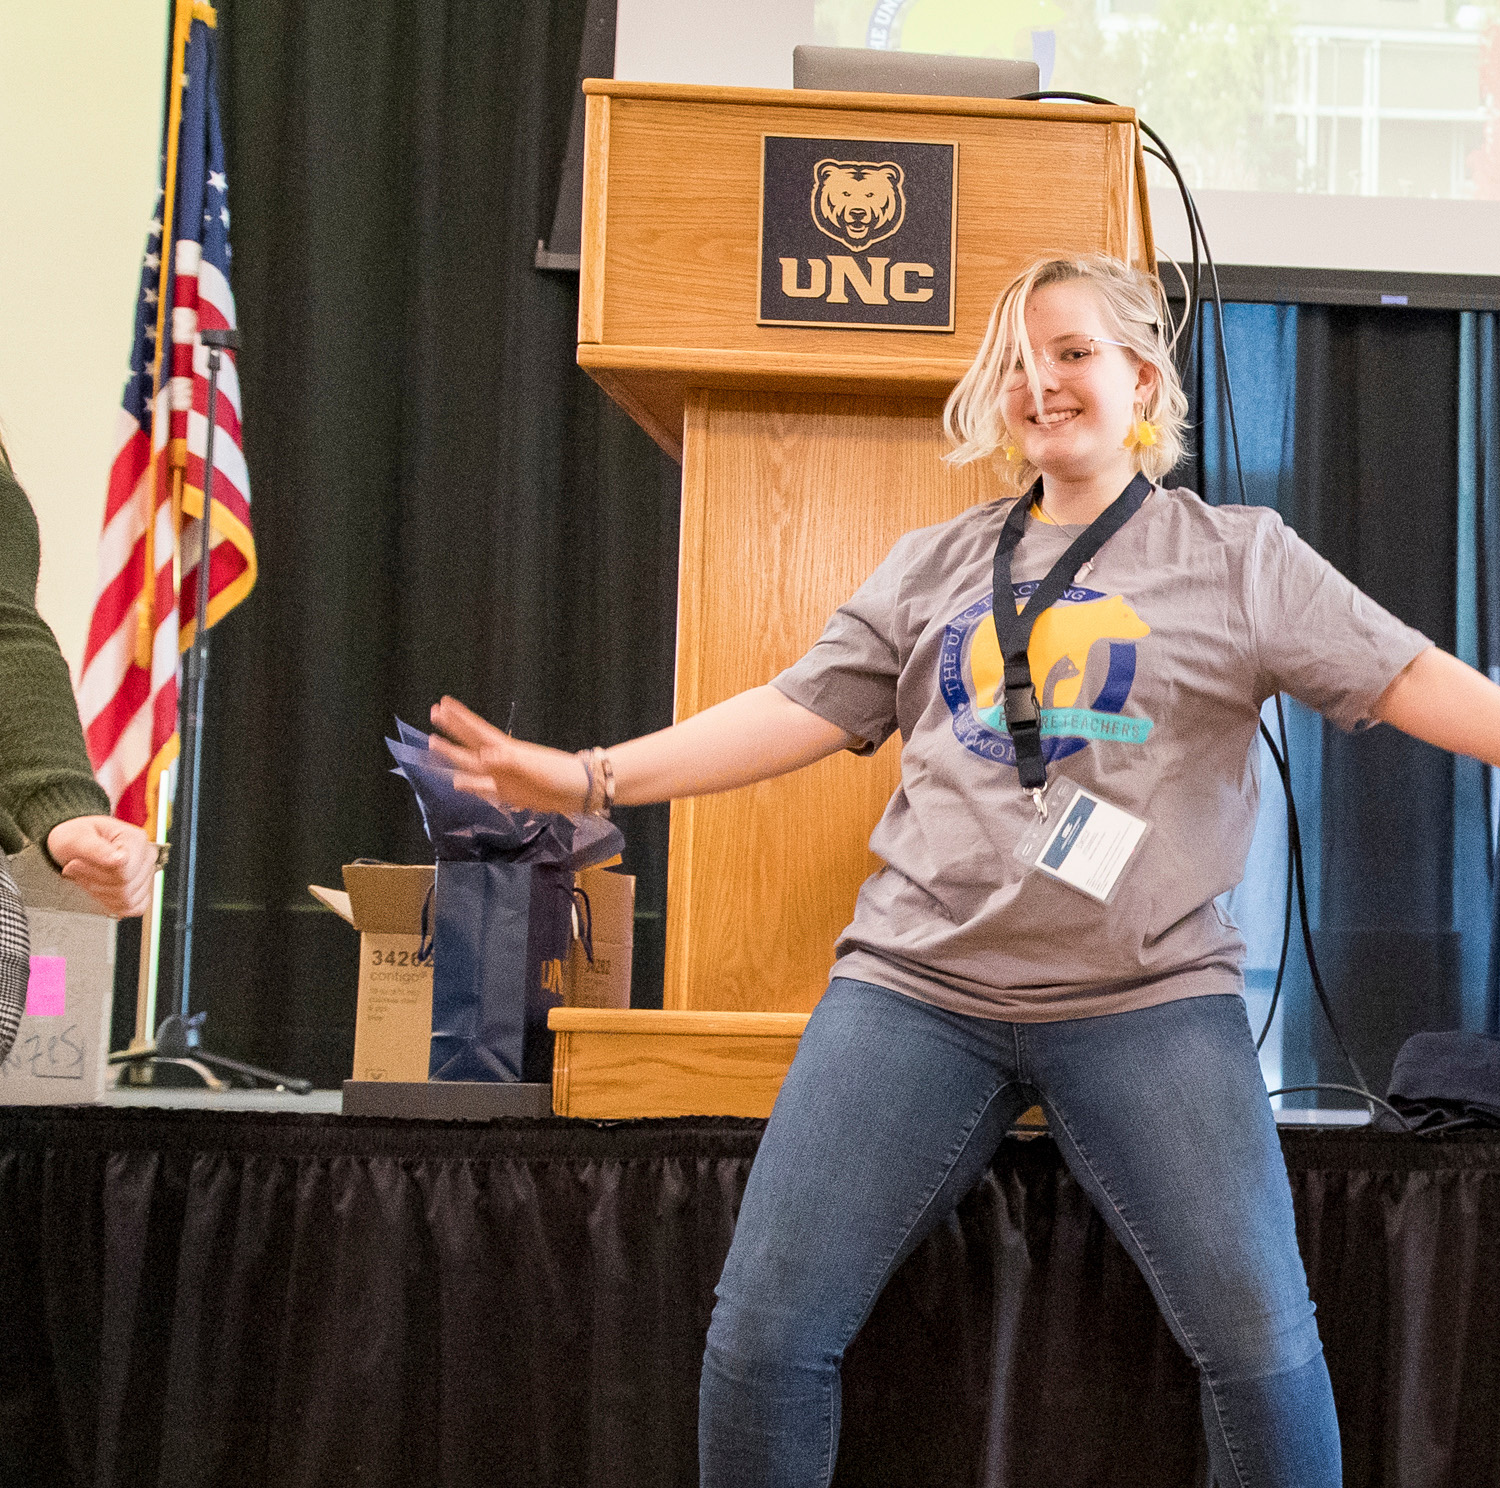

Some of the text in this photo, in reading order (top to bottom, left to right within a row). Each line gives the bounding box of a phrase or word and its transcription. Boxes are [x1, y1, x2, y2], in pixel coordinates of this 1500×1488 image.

[779, 255, 934, 305] UNC
[948, 608, 978, 646] UNC
[944, 652, 961, 696] THE
[1061, 714, 1141, 740] TEACHERS
